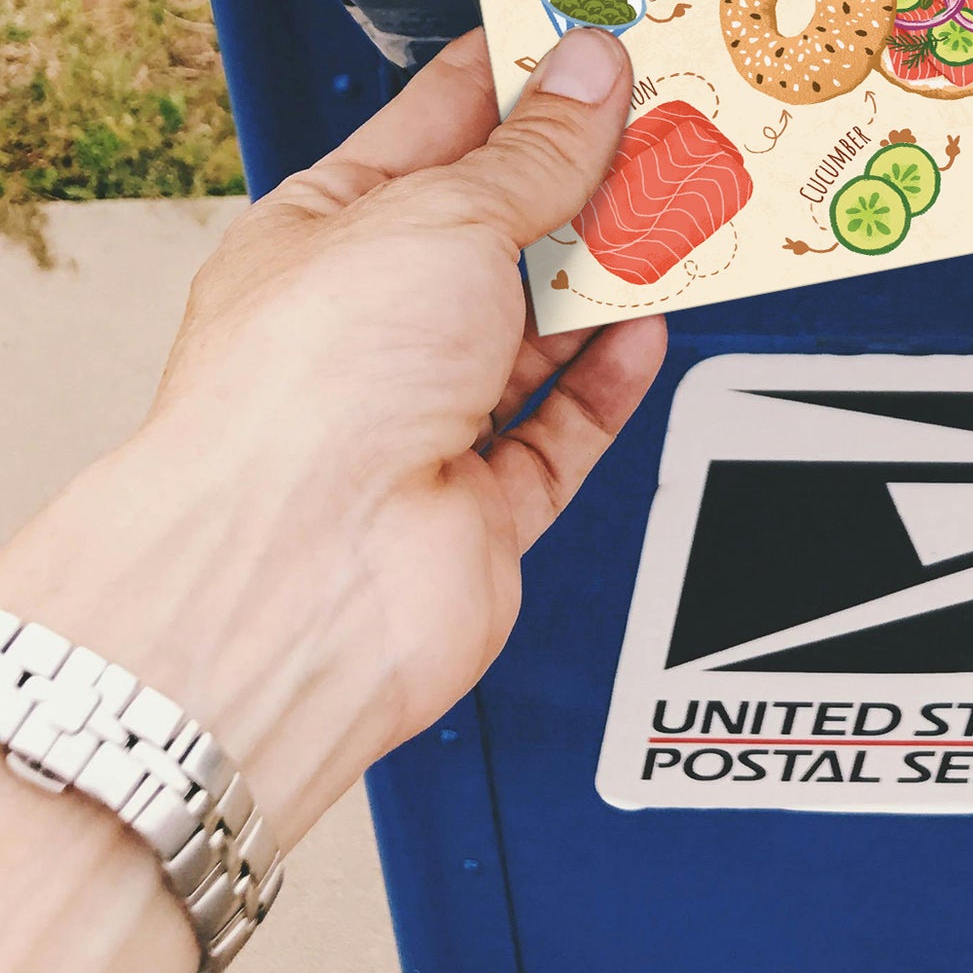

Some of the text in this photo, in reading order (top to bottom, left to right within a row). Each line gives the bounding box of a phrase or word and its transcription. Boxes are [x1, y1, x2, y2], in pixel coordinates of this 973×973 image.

[799, 125, 872, 204] CUCUMBER
[651, 699, 902, 736] UNITED
[640, 747, 880, 784] POSTAL
